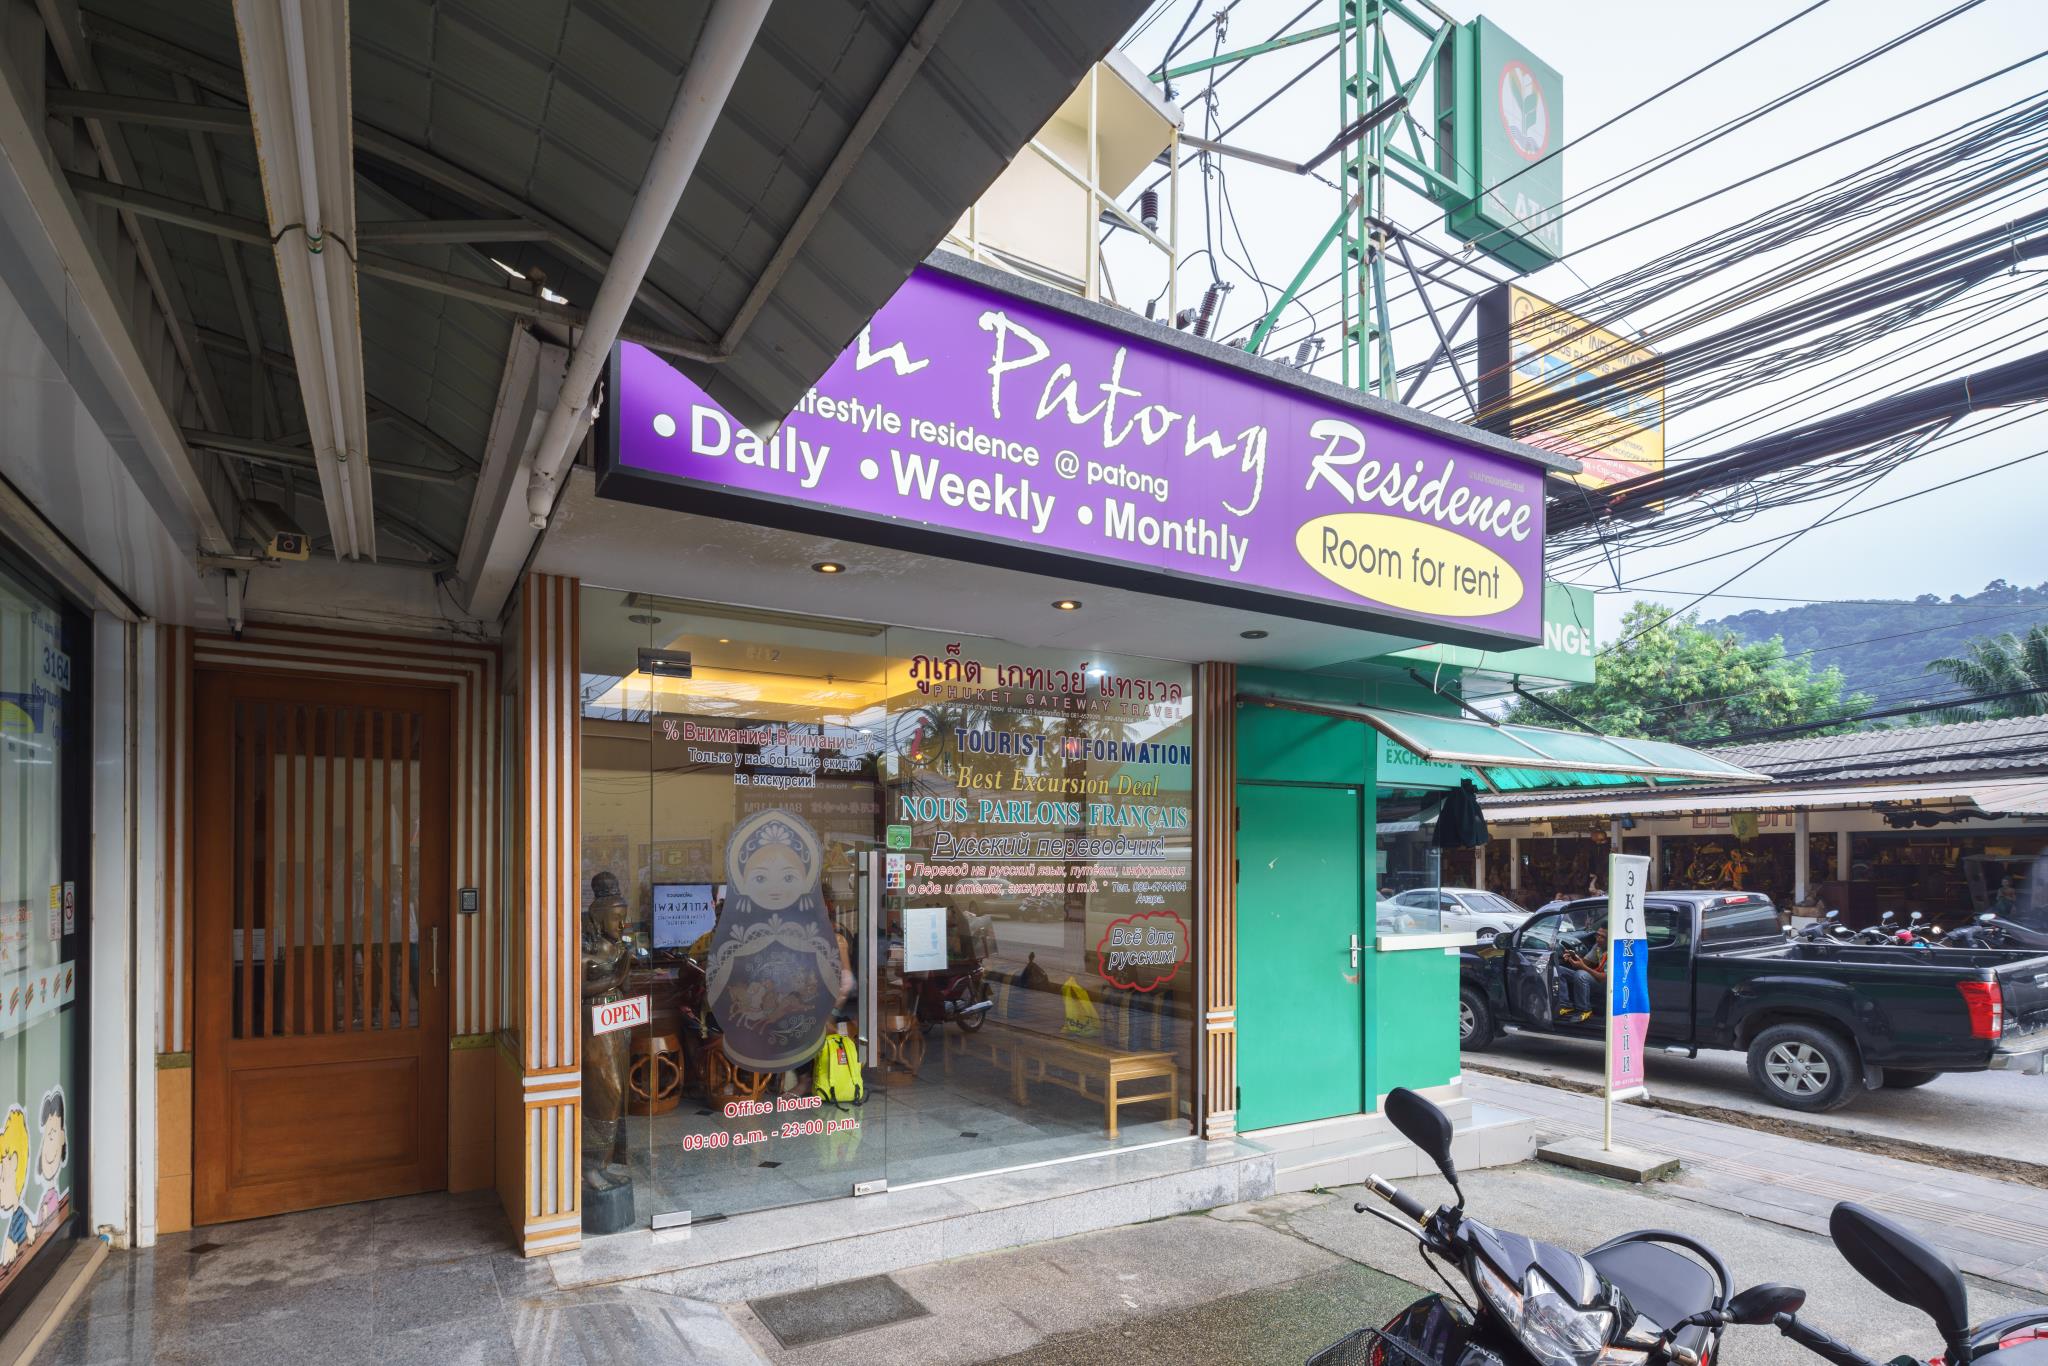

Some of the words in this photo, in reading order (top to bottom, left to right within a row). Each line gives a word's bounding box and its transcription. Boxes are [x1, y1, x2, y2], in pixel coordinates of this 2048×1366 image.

[977, 310, 1268, 517] Patong
[1304, 418, 1532, 542] Residence
[909, 416, 1041, 468] residence
[1054, 449, 1080, 480] @
[1087, 457, 1169, 503] patong
[690, 403, 831, 488] Daily
[890, 448, 1056, 535] Weekly
[1104, 496, 1249, 573] Monthly
[1322, 526, 1402, 580] Room
[1411, 547, 1445, 588] for
[1453, 562, 1500, 599] rent
[43, 647, 69, 687] 3164
[908, 642, 982, 695] ภูเก็ต
[997, 661, 1089, 695] เกทเวย์
[1099, 672, 1184, 706] แทรเวล
[933, 685, 1013, 704] PHUKET
[1025, 692, 1111, 712] GATEWAY
[1121, 702, 1184, 720] TRAVEL
[662, 719, 680, 742] %
[683, 721, 774, 746] Внимание!
[777, 727, 858, 750] Внимание!
[955, 727, 1047, 757] TOURIST
[1060, 736, 1191, 766] INFORMATION
[688, 747, 732, 764] Только
[734, 753, 743, 767] у
[744, 753, 766, 765] нас
[769, 752, 821, 769] большие
[822, 759, 862, 771] скидки
[733, 774, 750, 786] на
[752, 774, 816, 789] экскурсии!
[956, 766, 1002, 790] Best
[1010, 769, 1108, 796] Excursion
[1116, 774, 1160, 797] Deal
[900, 796, 968, 822] NOUS
[978, 800, 1080, 826] PARLONS
[1088, 803, 1188, 834] FRANÇAIS
[931, 831, 1030, 860] Русский
[1036, 836, 1166, 858] переводчик!
[912, 863, 969, 879] Перевод
[988, 864, 1036, 879] русский
[1112, 928, 1142, 945] Всё
[1146, 931, 1175, 945] для
[1109, 946, 1177, 970] русских!
[601, 1002, 641, 1026] OPEN
[724, 1101, 773, 1118] Office
[777, 1096, 822, 1112] hours
[683, 1132, 729, 1151] 09:00
[732, 1130, 767, 1145] a.m.
[782, 1118, 823, 1138] 23:00
[827, 1117, 859, 1135] p.m.
